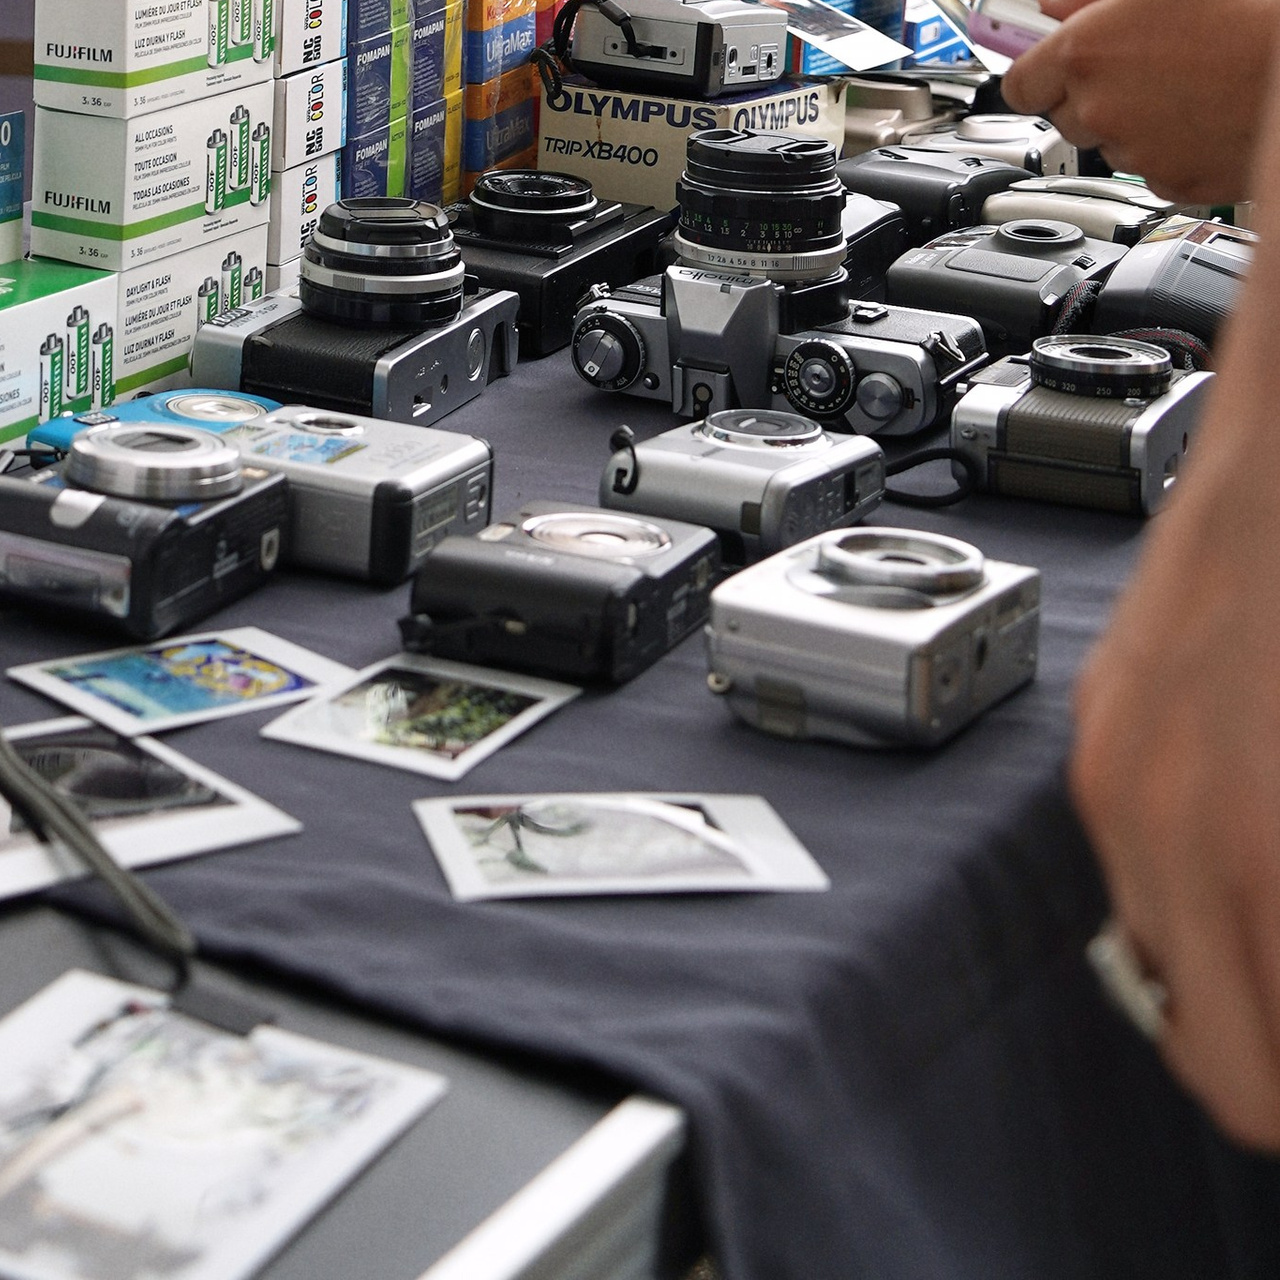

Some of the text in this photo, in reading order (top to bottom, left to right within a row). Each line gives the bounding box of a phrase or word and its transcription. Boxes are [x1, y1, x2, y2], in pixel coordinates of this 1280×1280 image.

[159, 5, 166, 15] DU
[167, 2, 179, 14] JOUR
[180, 1, 186, 11] ET
[134, 38, 145, 49] LUZ
[146, 34, 165, 47] DIURNA
[170, 29, 186, 41] FLASH
[414, 20, 444, 40] FOMAPAN
[47, 43, 112, 62] FUJIFILM
[303, 38, 314, 63] NC
[313, 35, 322, 60] 500
[357, 44, 390, 66] FOMAPAN
[486, 29, 532, 62] UltraMax
[92, 98, 102, 106] 36
[311, 72, 324, 121] COLOR
[415, 111, 444, 132] FOMAPAN
[547, 91, 718, 131] OLYMPUS
[734, 92, 819, 131] OLYMPUS
[135, 124, 173, 143] ALL OCCASIONS
[306, 129, 316, 156] NC
[316, 127, 324, 152] 500
[486, 117, 530, 150] UltraMax
[134, 159, 151, 172] TOUTE
[152, 152, 177, 168] OCCASION
[356, 139, 388, 162] FOMAPAN
[133, 187, 151, 201] TODAS
[152, 184, 162, 196] LAS
[162, 176, 190, 193] OCASIONES
[305, 164, 318, 214] COLOR
[45, 190, 111, 214] FUJIFILM
[88, 248, 99, 257] 36
[126, 280, 151, 298] DAYLIGHT
[155, 274, 171, 287] FLASH
[679, 270, 754, 285] minolta
[149, 309, 156, 319] DU
[156, 303, 169, 316] JOUR
[170, 300, 176, 311] ET
[176, 294, 192, 308] FLASH
[124, 343, 134, 356] LUZ
[135, 336, 154, 352] DIURNA
[159, 329, 175, 342] FLASH
[1061, 382, 1076, 392] 320
[1096, 387, 1111, 395] 250
